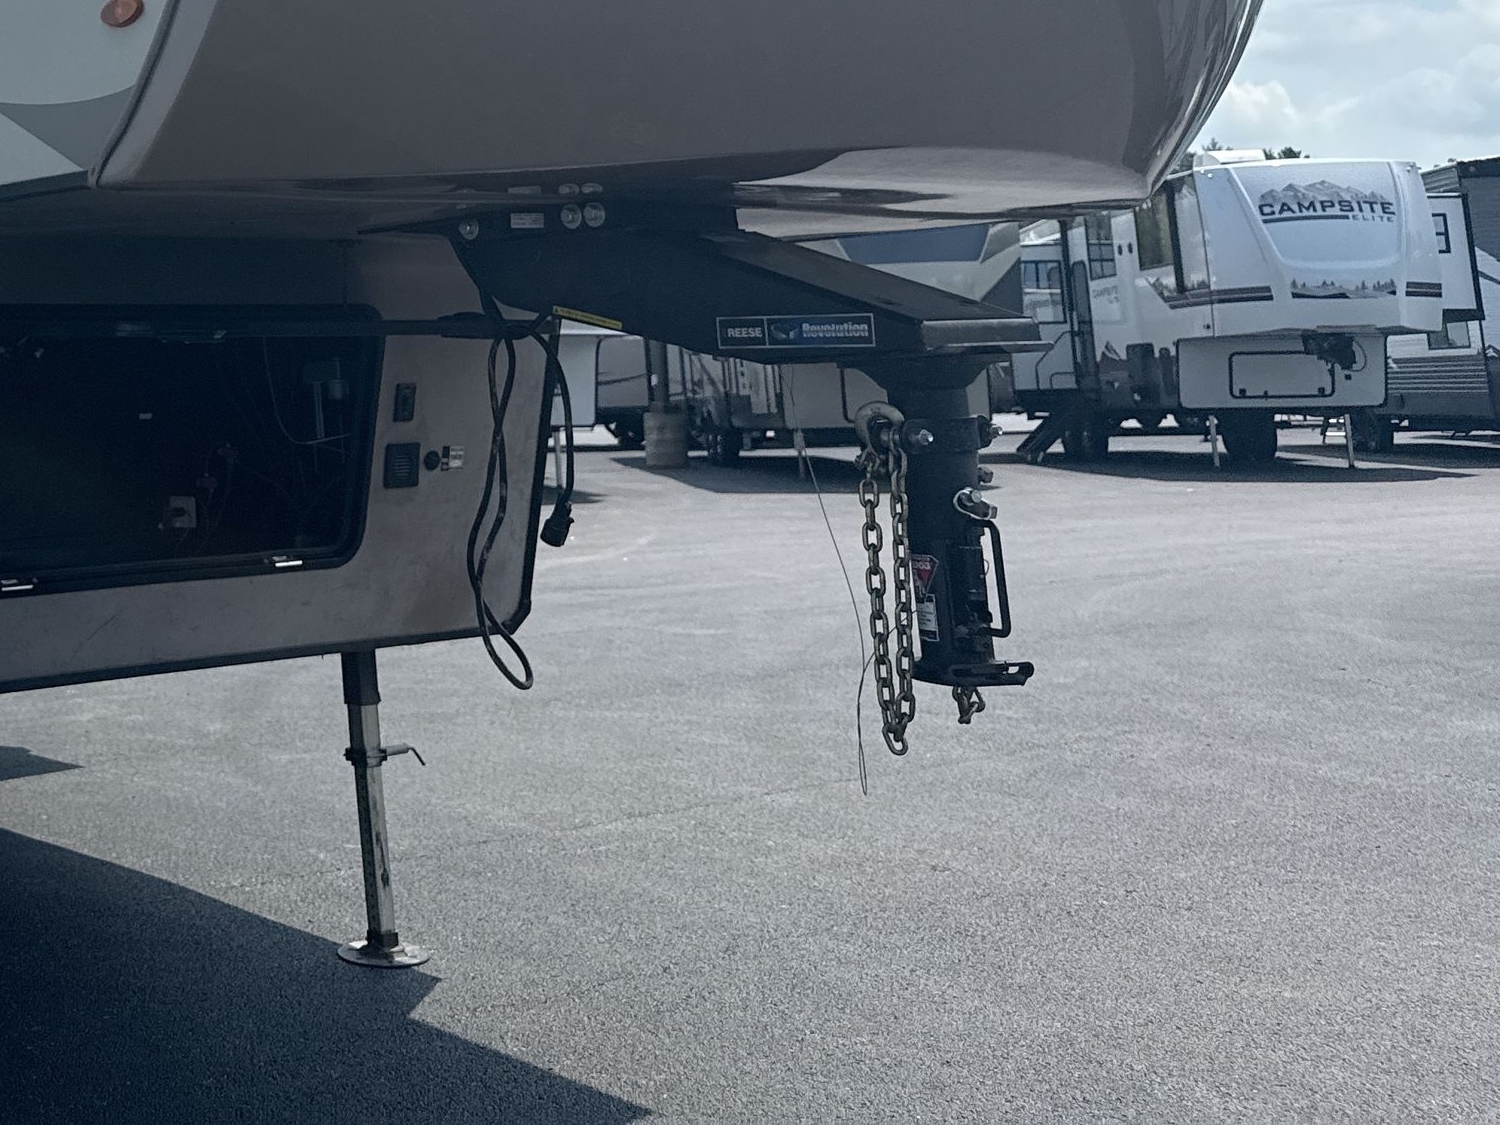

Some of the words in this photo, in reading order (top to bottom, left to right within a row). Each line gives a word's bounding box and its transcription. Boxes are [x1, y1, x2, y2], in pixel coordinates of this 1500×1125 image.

[1258, 200, 1396, 217] CAMPSITE
[1352, 214, 1395, 223] ELITE
[727, 327, 763, 338] REESE
[801, 321, 869, 338] Revolution
